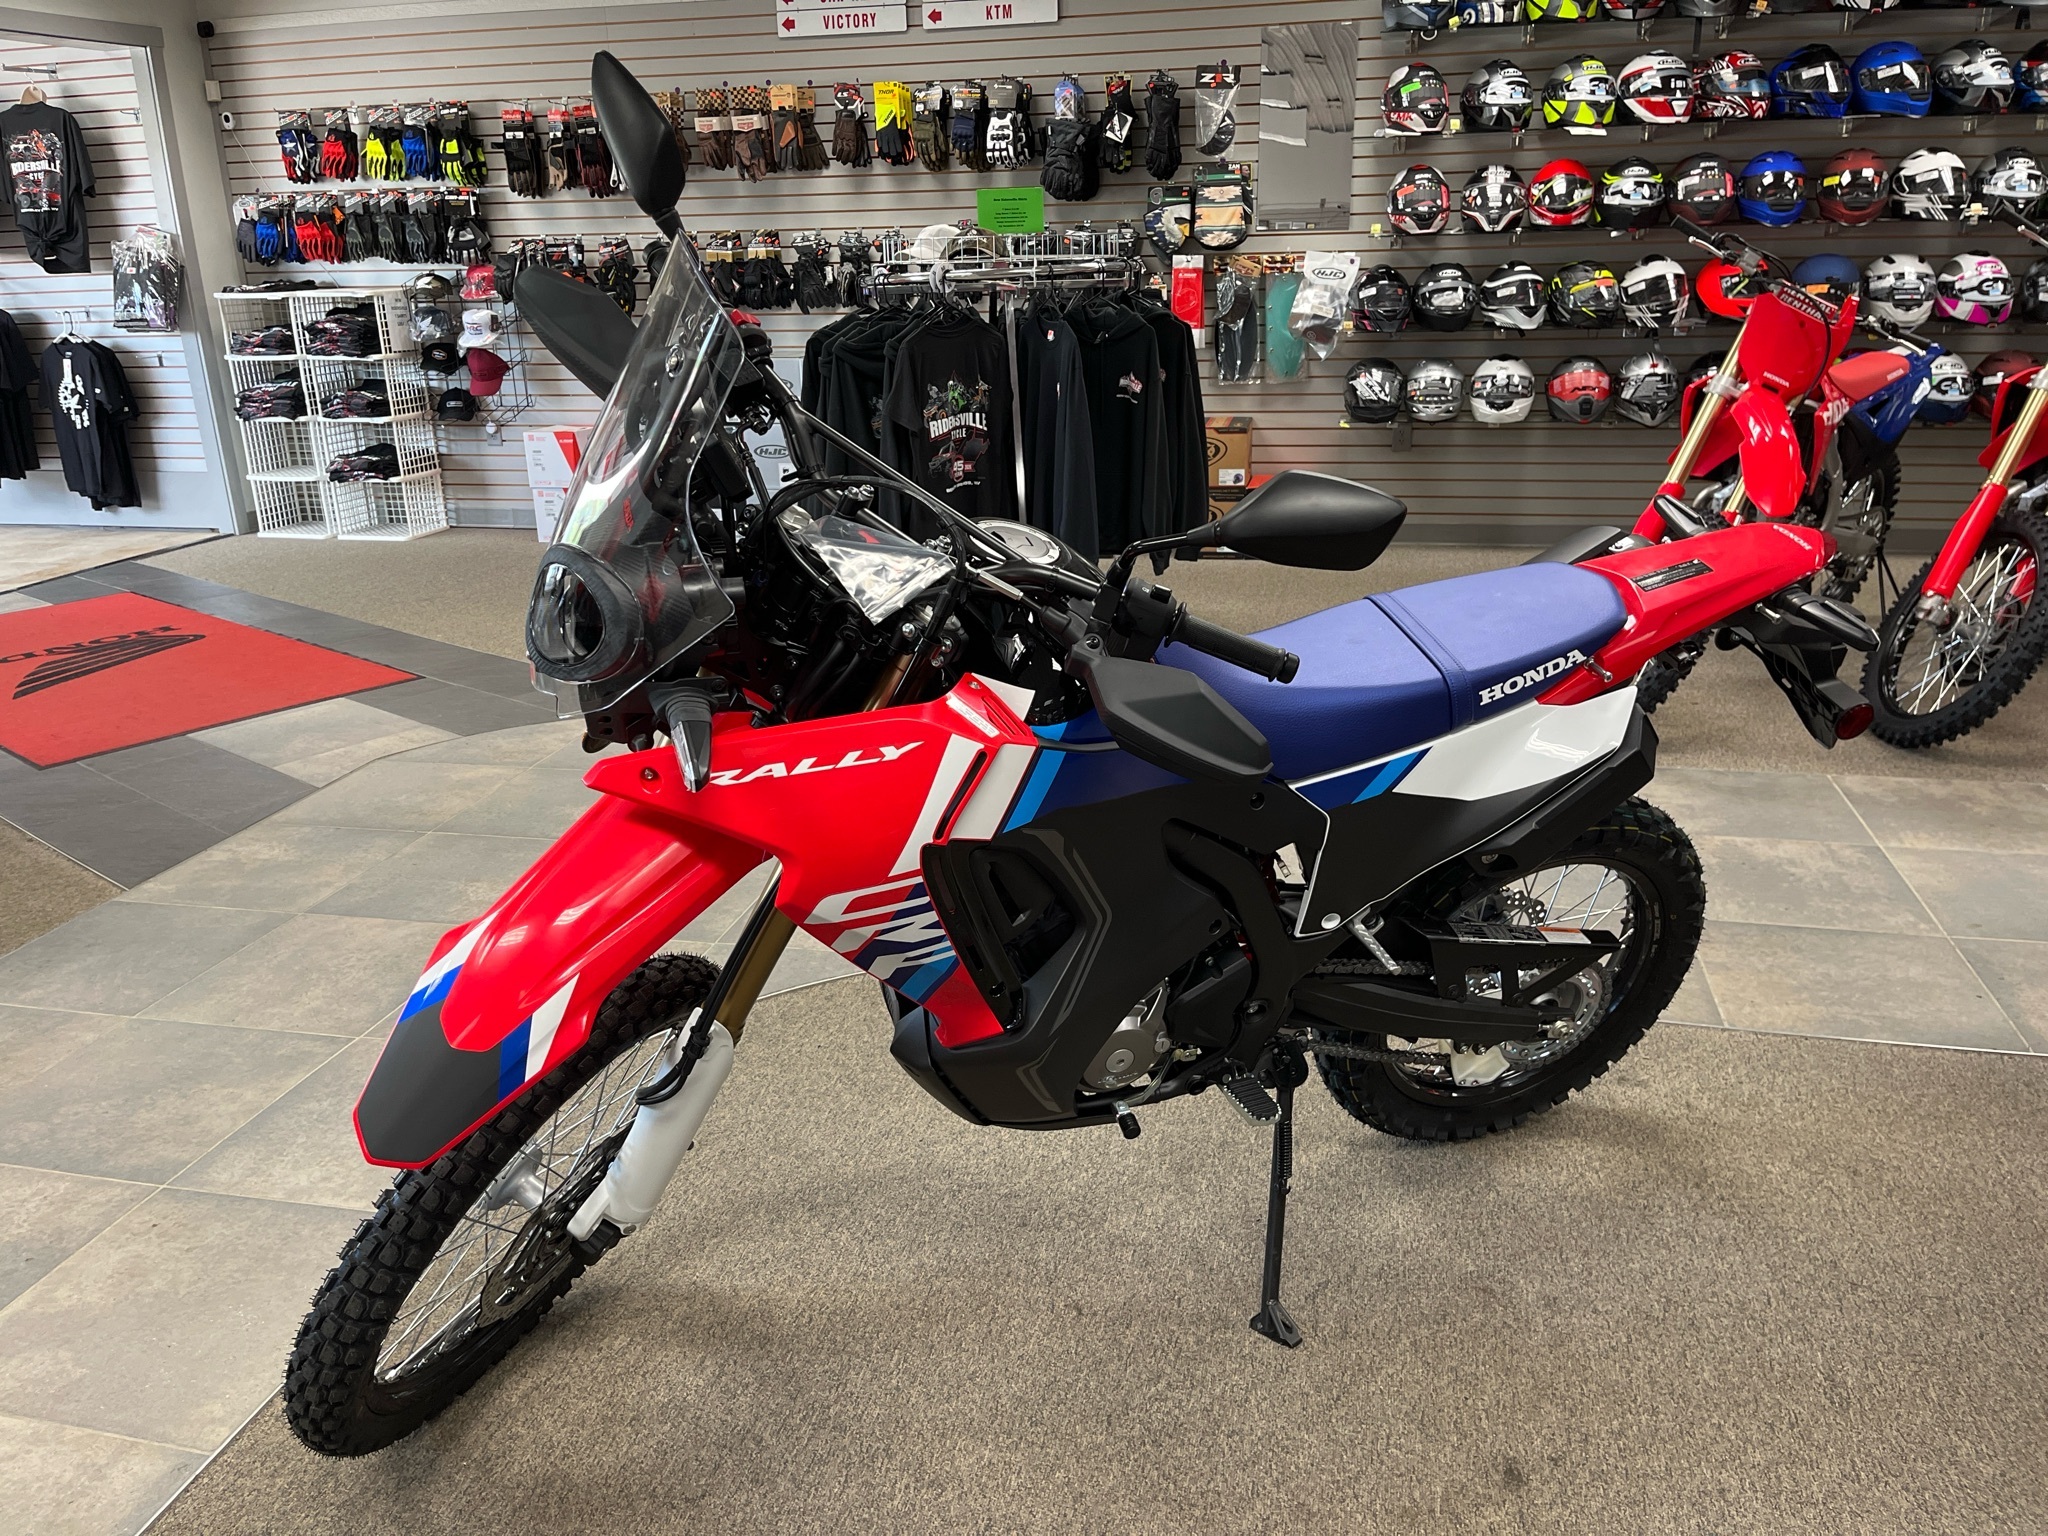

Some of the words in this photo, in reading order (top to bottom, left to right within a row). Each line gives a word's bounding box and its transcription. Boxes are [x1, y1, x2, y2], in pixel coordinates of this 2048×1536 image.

[823, 12, 877, 30] VICTORY
[986, 3, 1013, 21] KTM
[883, 109, 894, 124] THOR
[1316, 268, 1344, 280] HJC
[1780, 293, 1825, 322] RENTHA
[1763, 371, 1790, 389] HONDA
[929, 412, 988, 439] RIDERSVILLE
[759, 447, 788, 457] HJC
[1772, 524, 1813, 551] HONDA
[1479, 649, 1588, 706] HONDA
[710, 741, 925, 786] RALLY
